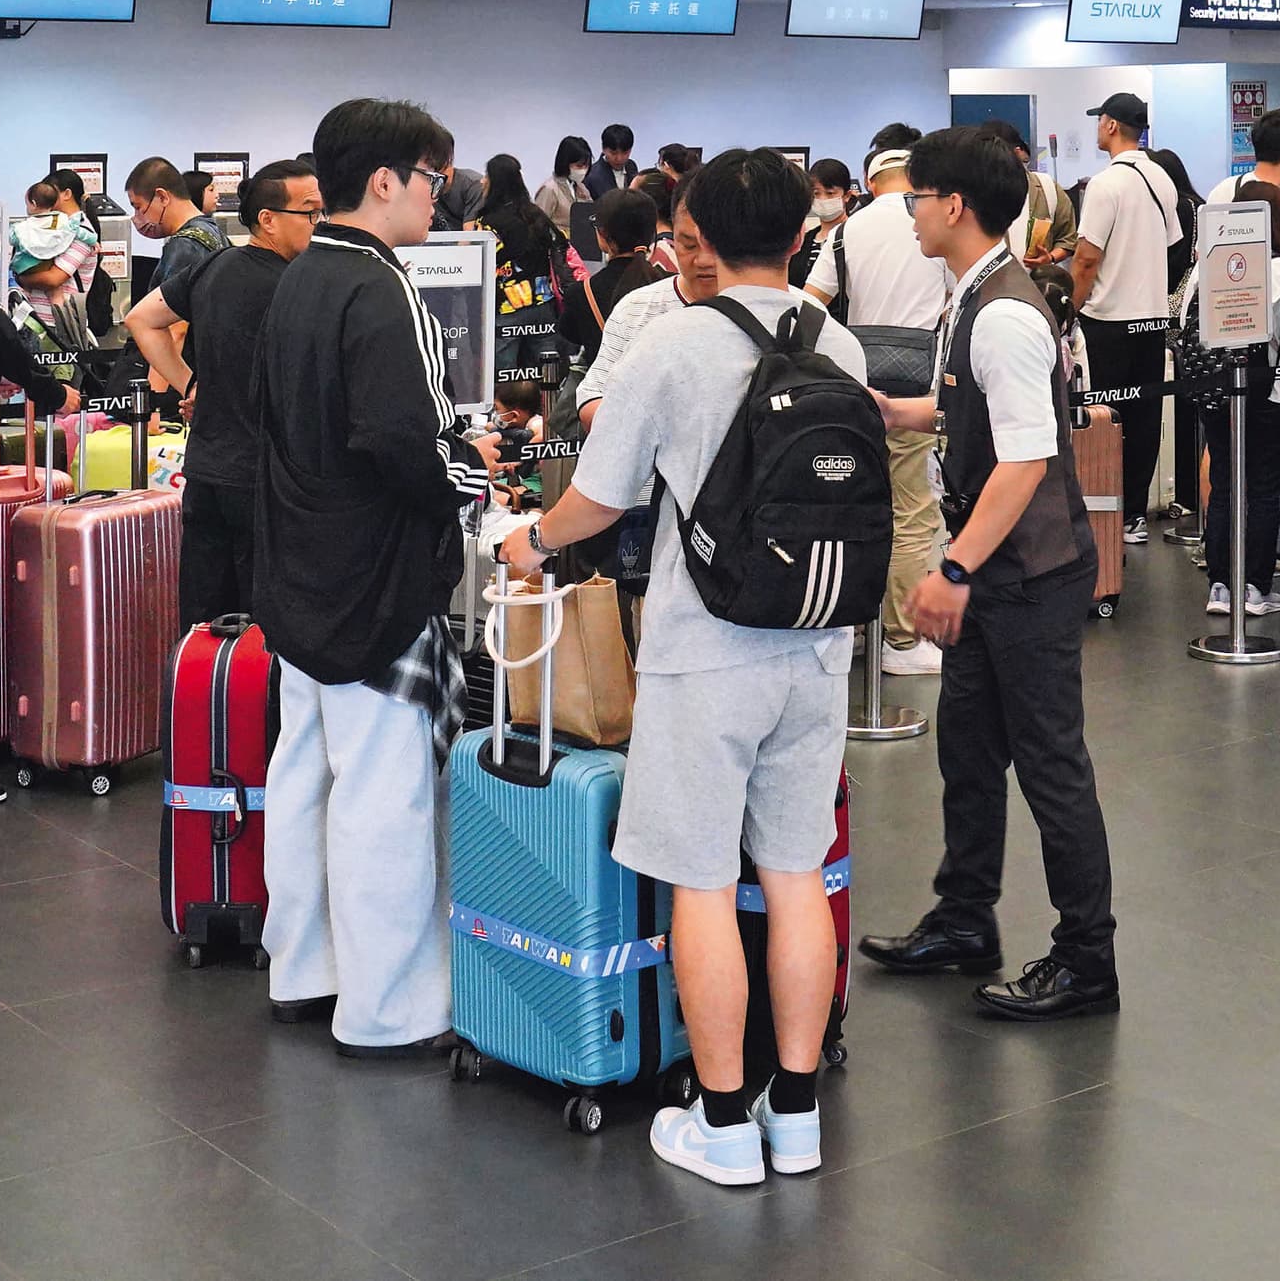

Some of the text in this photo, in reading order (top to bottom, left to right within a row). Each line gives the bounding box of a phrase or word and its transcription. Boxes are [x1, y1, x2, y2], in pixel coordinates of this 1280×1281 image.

[1090, 1, 1162, 19] STARLUX
[1189, 6, 1217, 22] Security
[417, 266, 463, 275] STARLUX
[501, 323, 556, 337] STARLUX
[1127, 319, 1170, 334] STARLUX
[1082, 386, 1142, 405] STARLUX
[815, 459, 853, 470] adidas
[501, 926, 572, 968] TAIWAN
